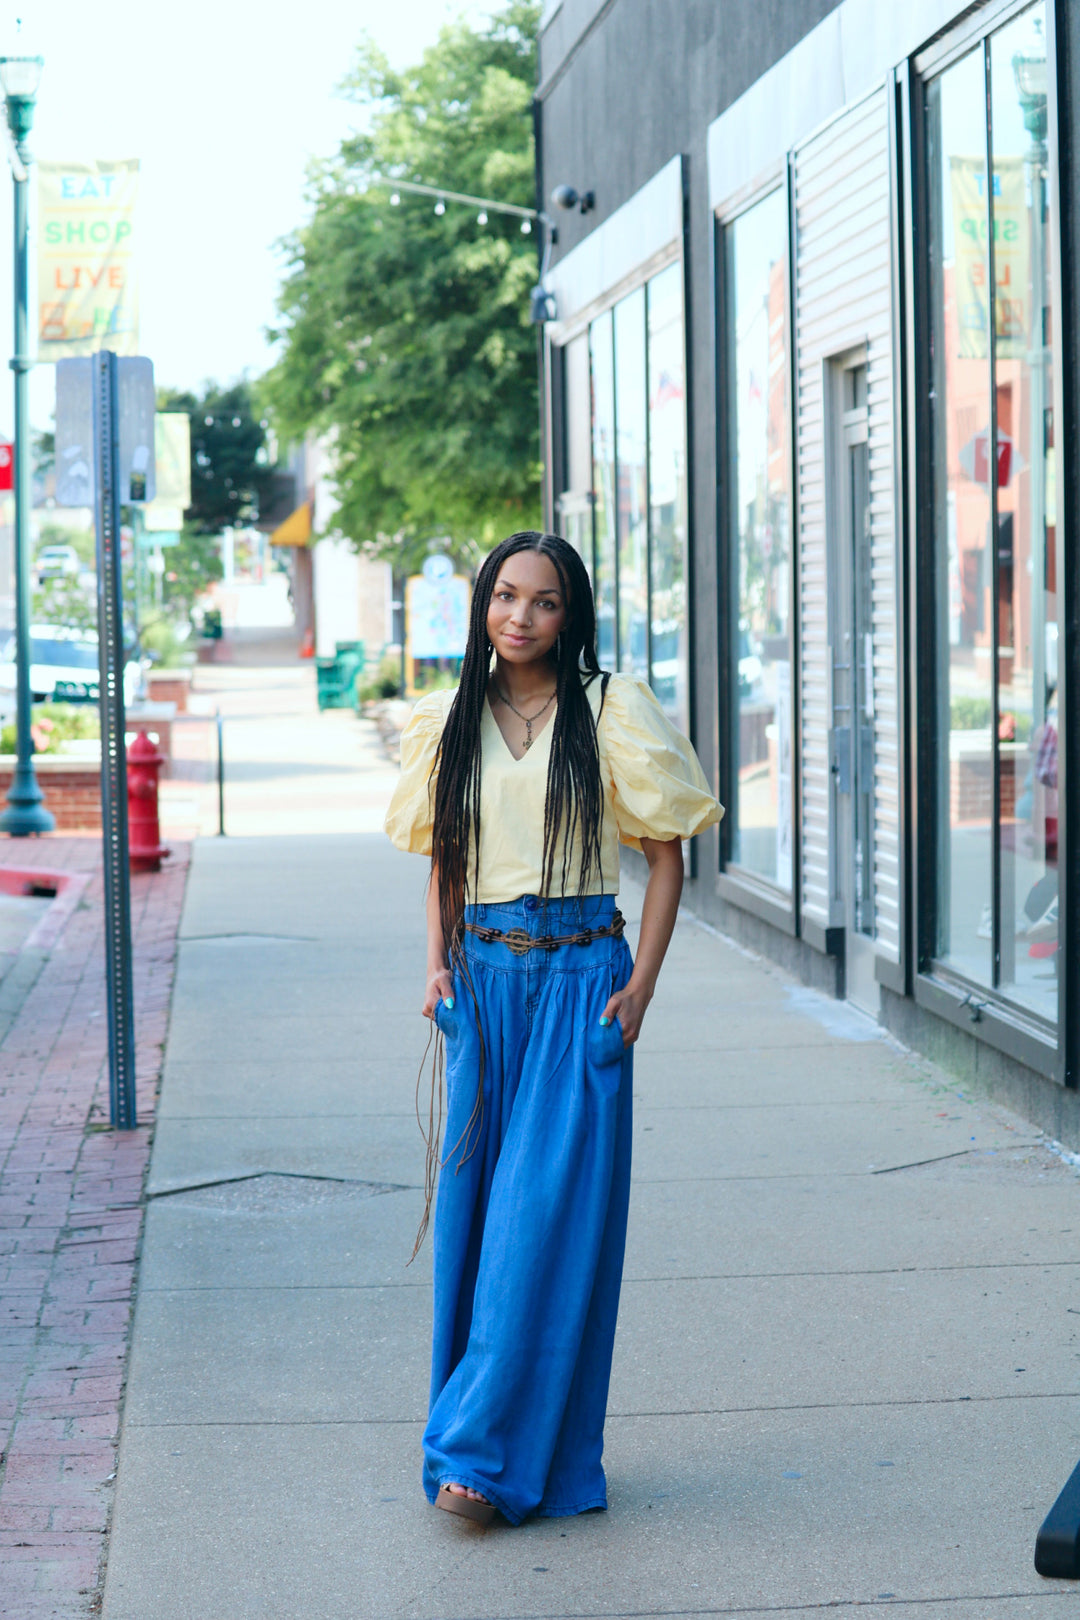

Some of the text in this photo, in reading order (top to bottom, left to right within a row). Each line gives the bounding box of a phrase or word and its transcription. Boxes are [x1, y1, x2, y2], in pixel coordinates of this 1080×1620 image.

[61, 176, 116, 198] EAT
[45, 221, 131, 243] SHOP
[55, 266, 123, 289] LIVE
